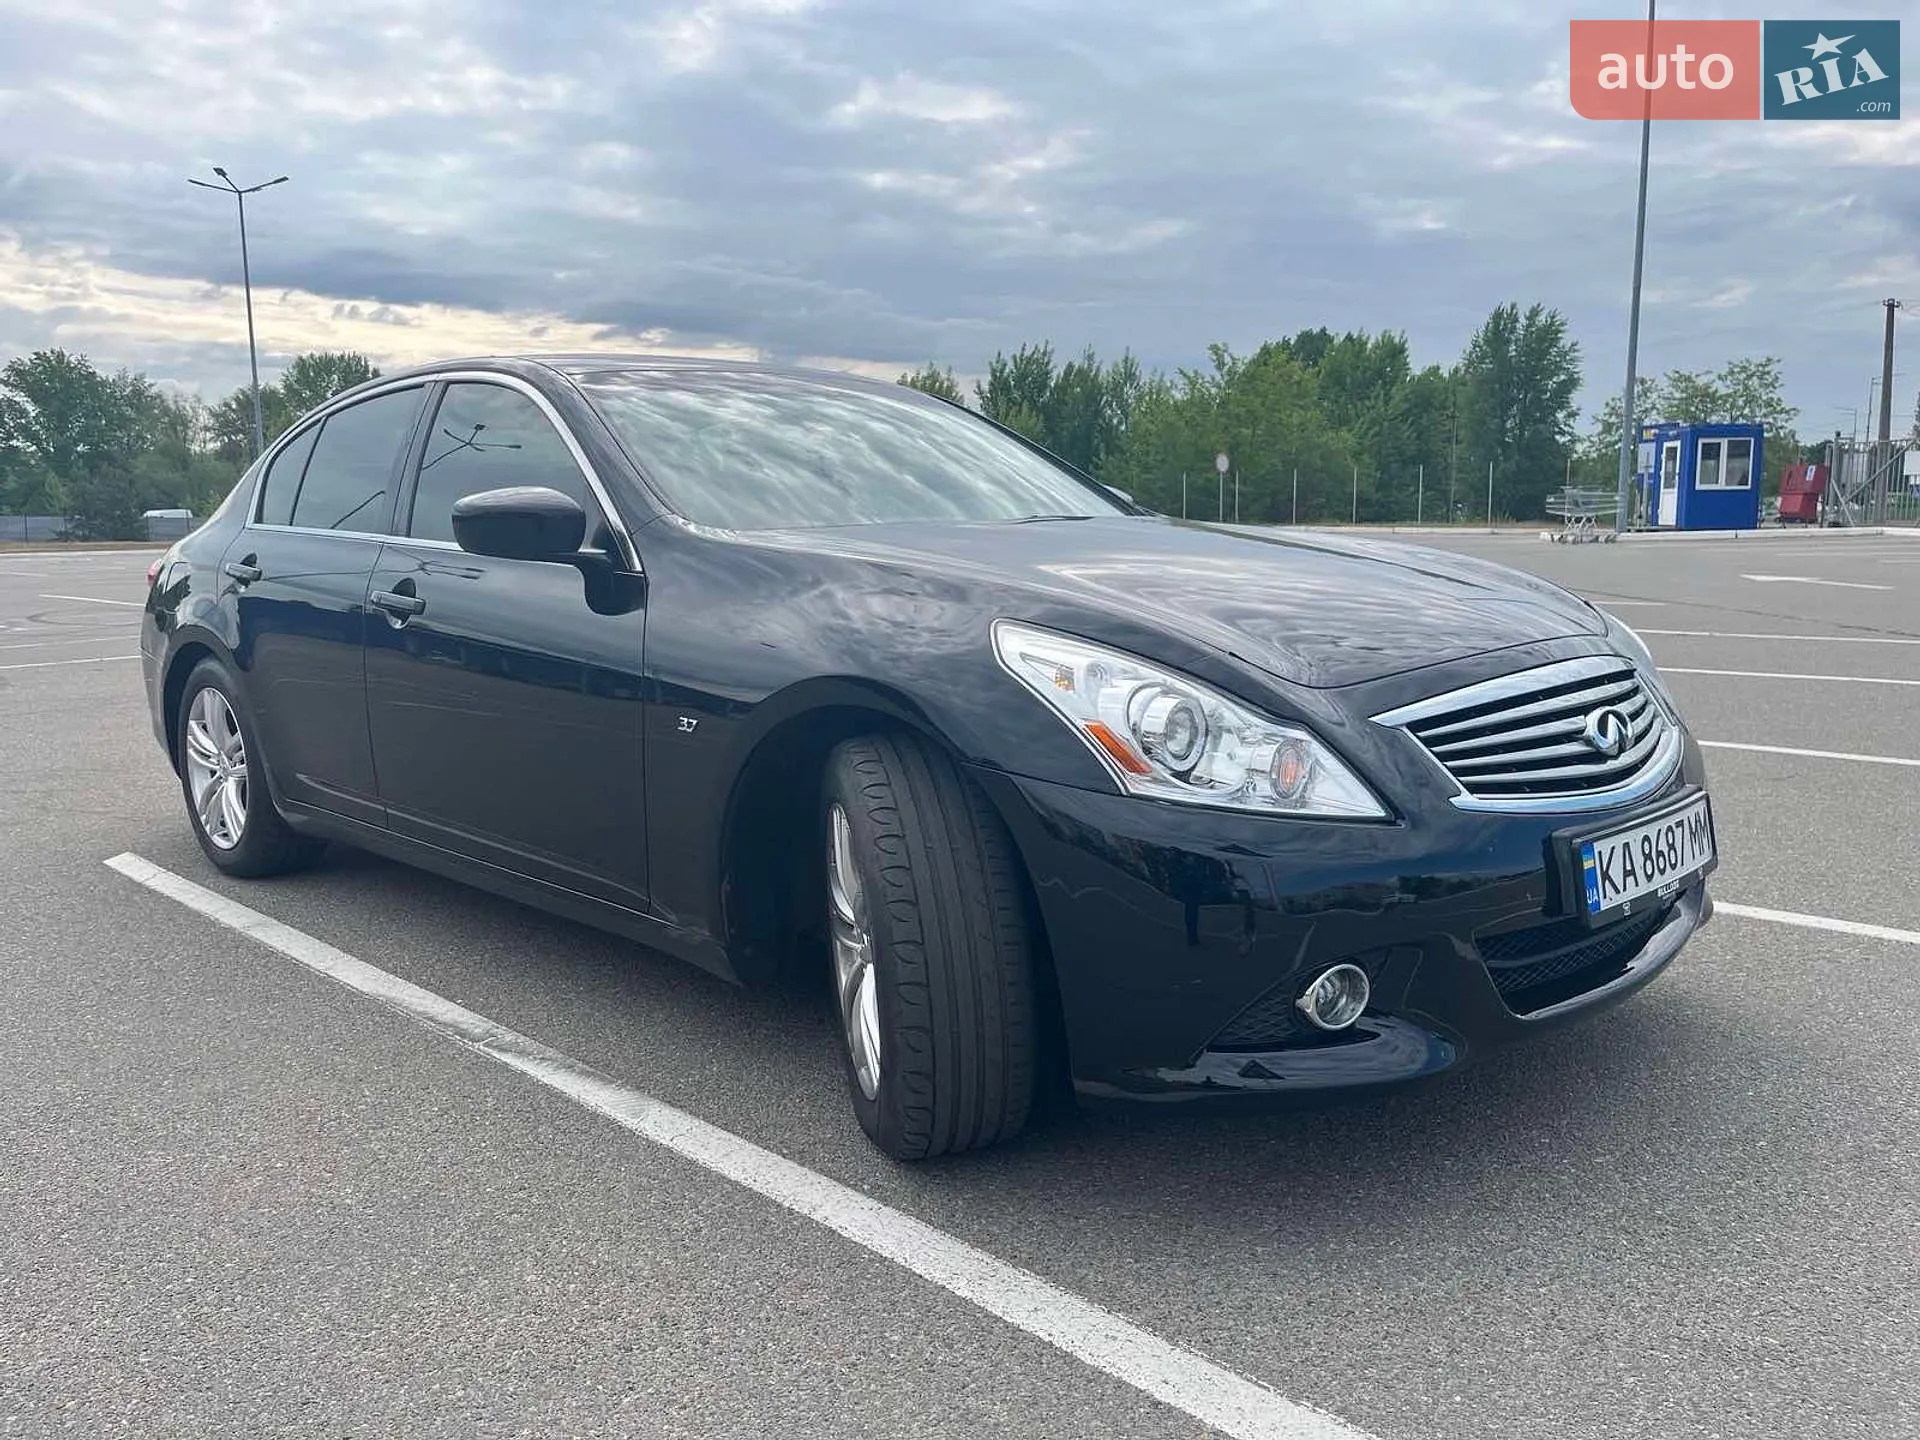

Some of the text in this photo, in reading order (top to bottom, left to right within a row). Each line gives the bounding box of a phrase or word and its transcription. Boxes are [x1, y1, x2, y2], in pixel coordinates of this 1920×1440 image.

[1598, 806, 1711, 899] KA 8687 MM
[1586, 888, 1601, 905] UA
